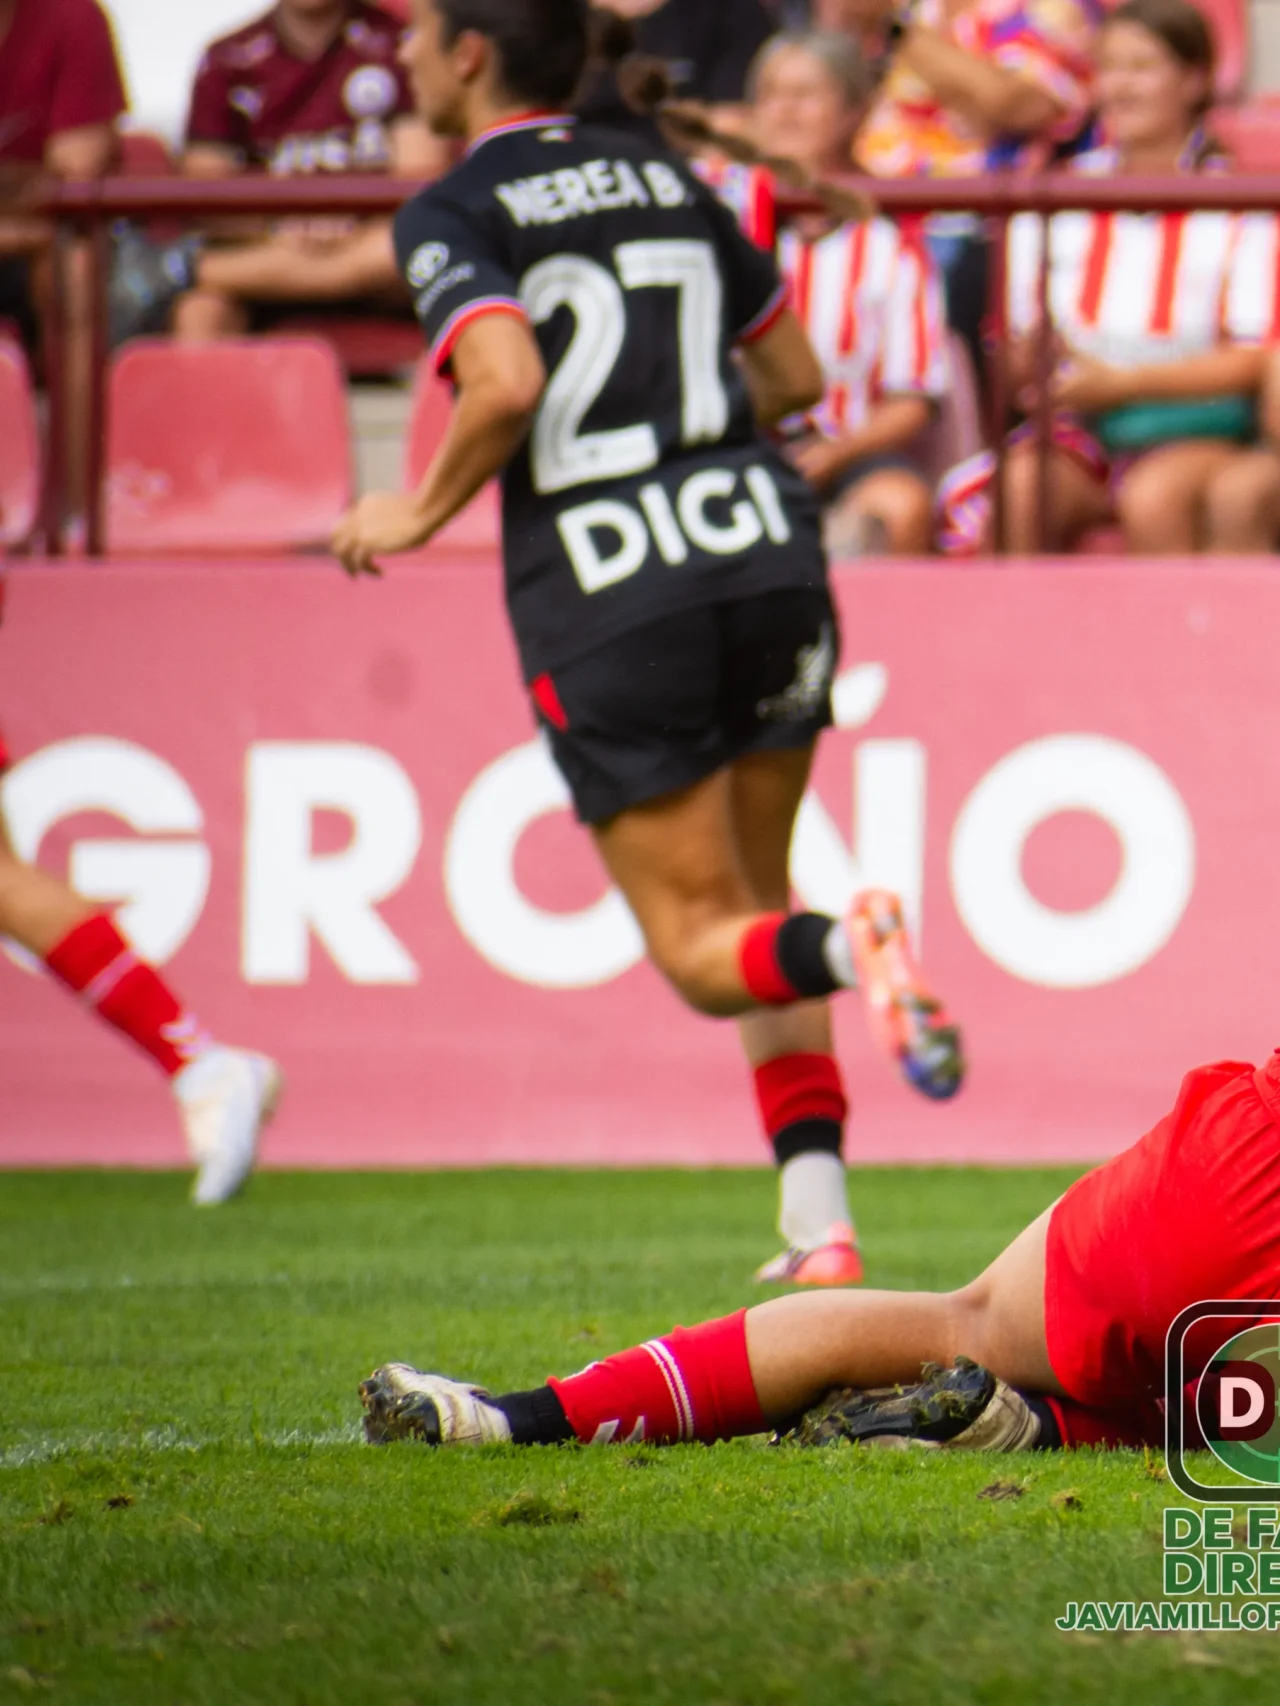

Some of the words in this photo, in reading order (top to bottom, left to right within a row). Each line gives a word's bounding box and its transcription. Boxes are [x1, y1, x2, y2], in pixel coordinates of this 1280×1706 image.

[494, 157, 650, 228] NEREA
[518, 239, 728, 494] 27
[556, 466, 791, 594] DIGI
